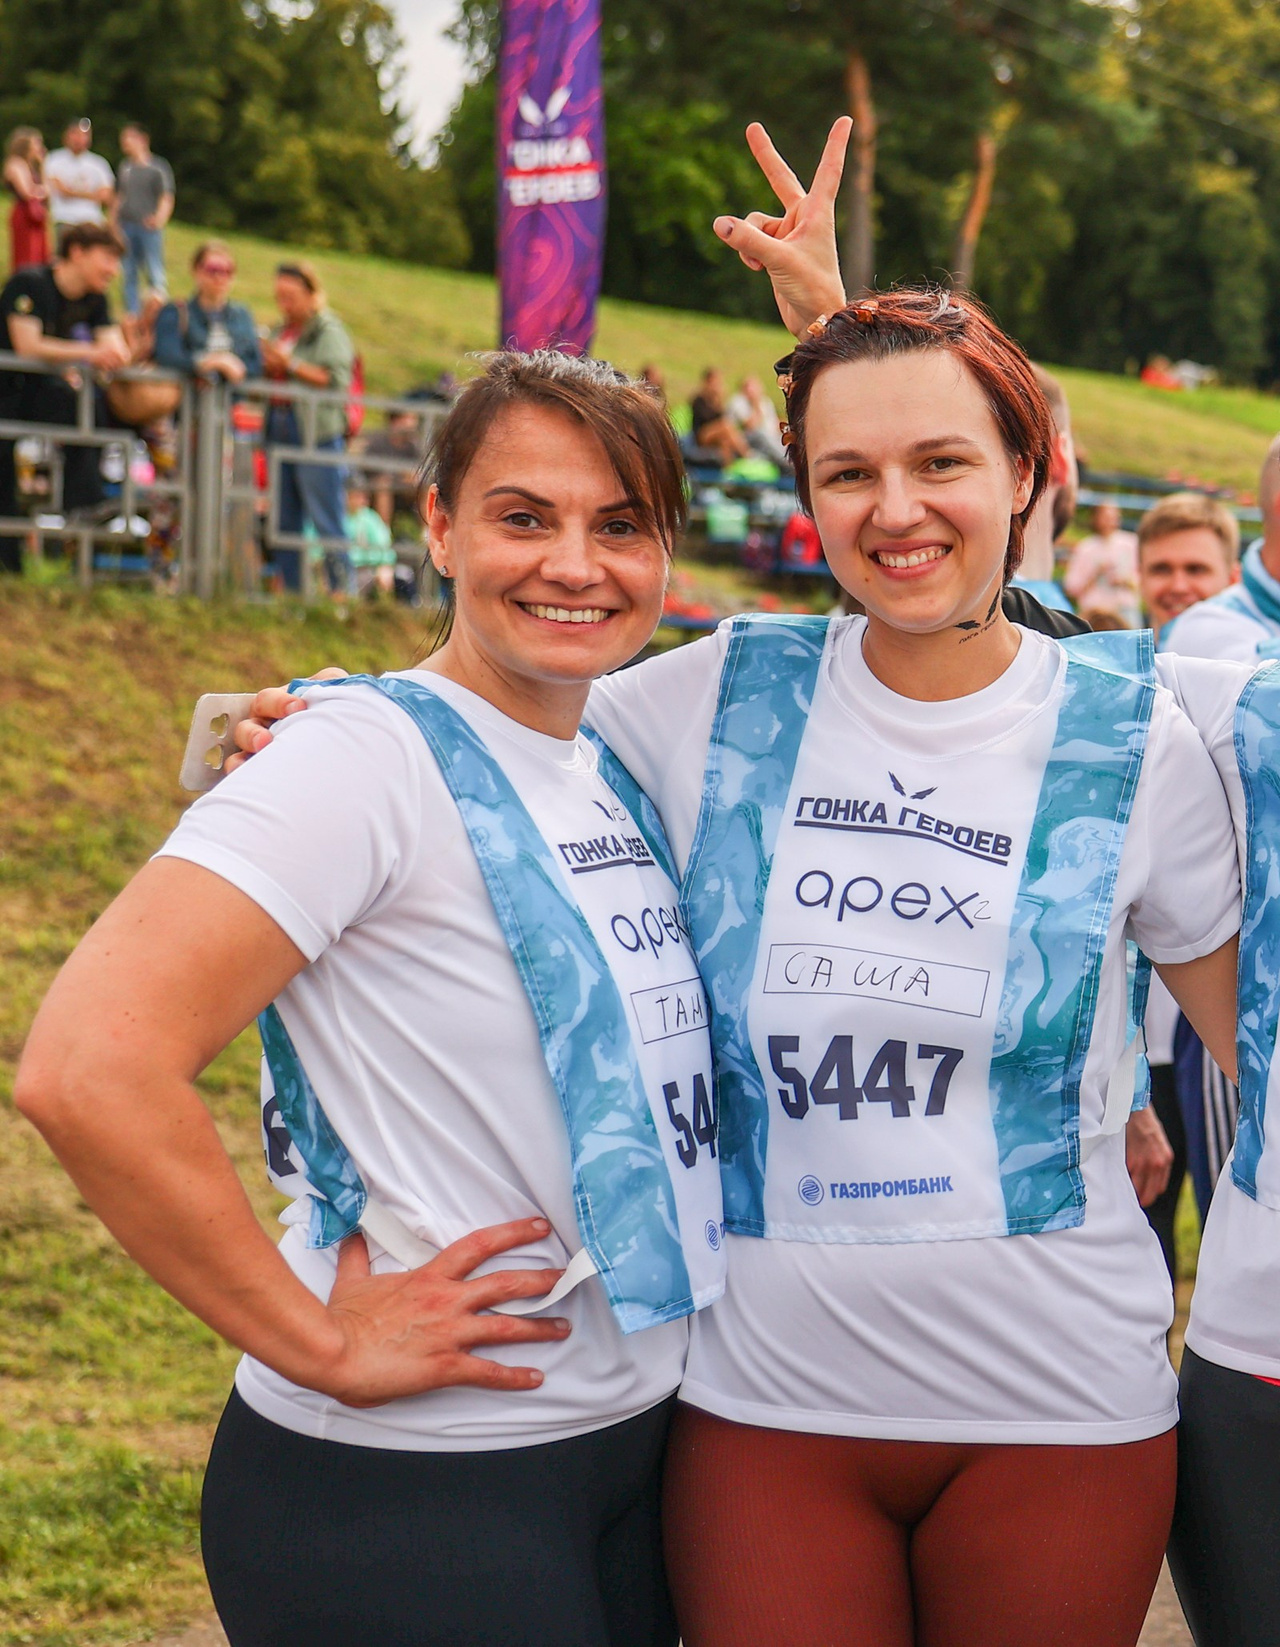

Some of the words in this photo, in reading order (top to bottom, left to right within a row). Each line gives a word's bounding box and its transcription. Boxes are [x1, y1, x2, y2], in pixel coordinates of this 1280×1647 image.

[558, 834, 626, 865] ГОНКА
[796, 797, 888, 824] ГОНКА
[898, 807, 1012, 858] ГЕРОЕВ
[796, 870, 980, 929] apex
[768, 1035, 963, 1121] 5447
[663, 1073, 717, 1169] 54
[830, 1176, 954, 1199] ГАЗПРОМБАНК
